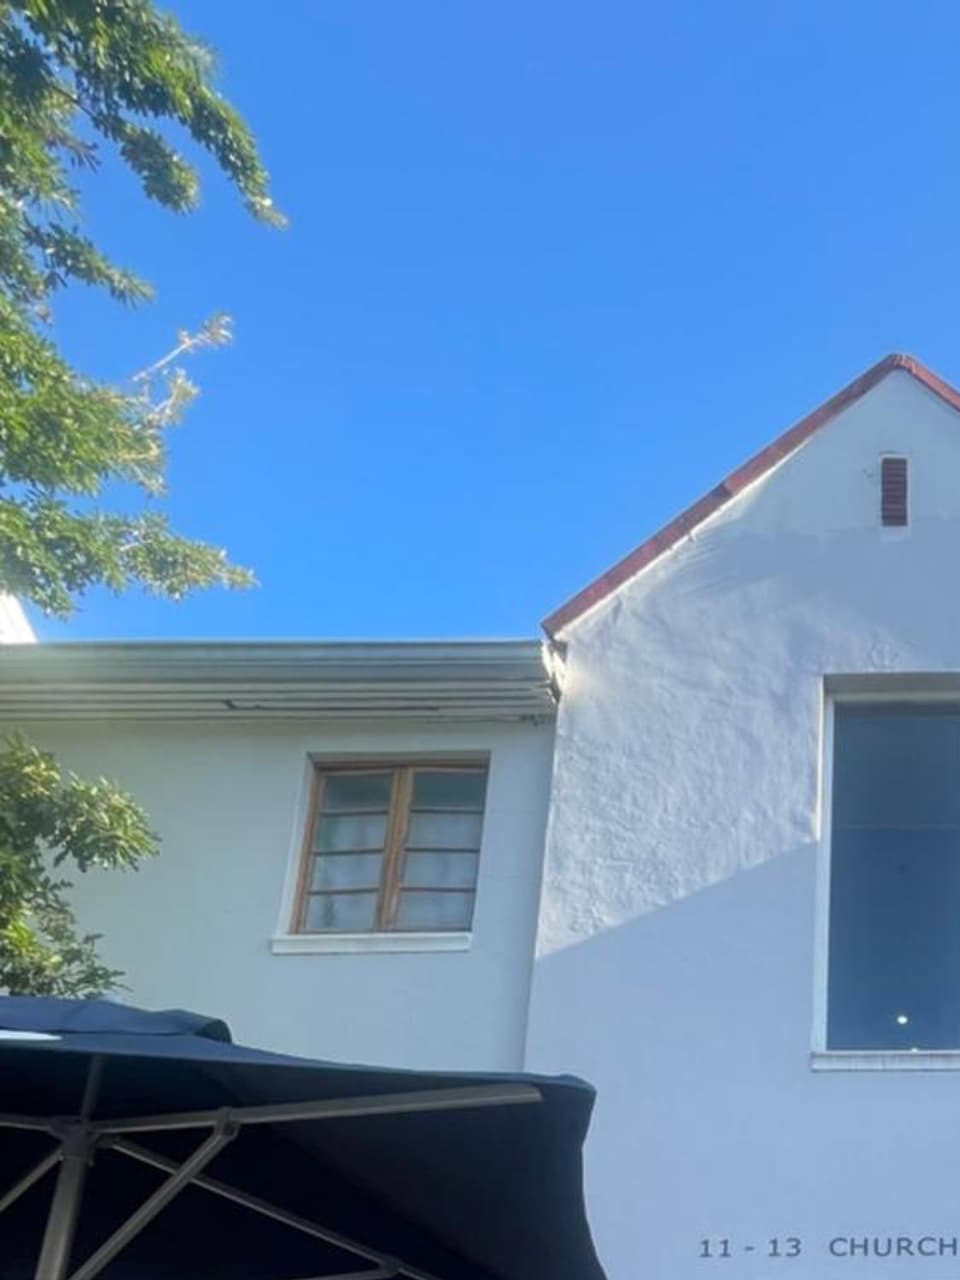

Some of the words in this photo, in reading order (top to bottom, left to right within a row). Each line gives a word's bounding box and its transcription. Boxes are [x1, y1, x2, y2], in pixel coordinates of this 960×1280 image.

[699, 1238, 731, 1258] 11
[768, 1237, 802, 1257] 13
[828, 1236, 958, 1257] CHURCH
